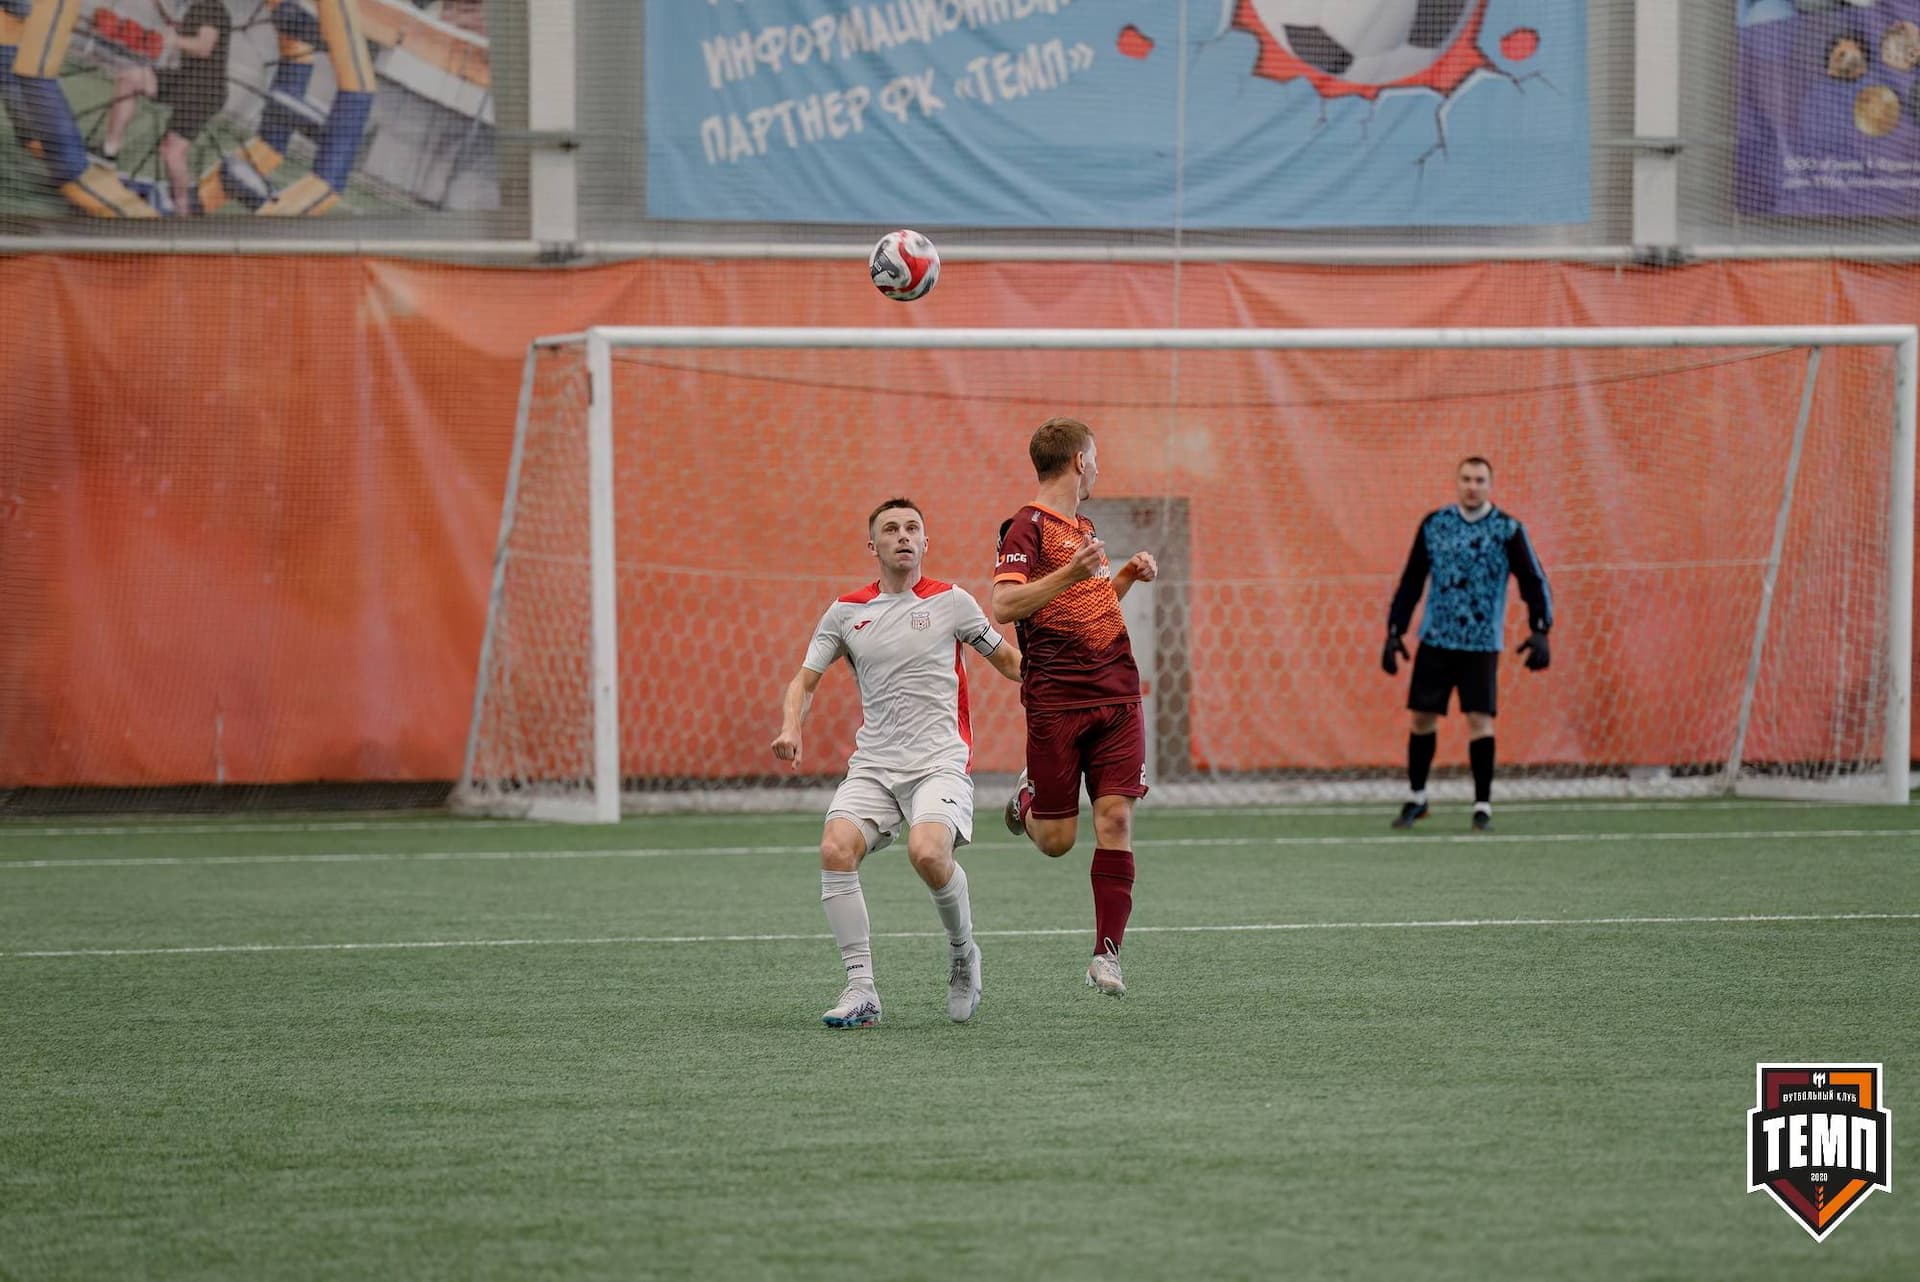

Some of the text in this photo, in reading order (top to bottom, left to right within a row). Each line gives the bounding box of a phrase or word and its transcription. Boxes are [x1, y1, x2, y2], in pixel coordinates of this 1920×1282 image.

[703, 0, 1072, 88] ИНФОРМАЦИОНН
[702, 39, 1095, 163] ПАРТНЕР ФК «ТЕМП»
[1006, 552, 1027, 564] ПСБ
